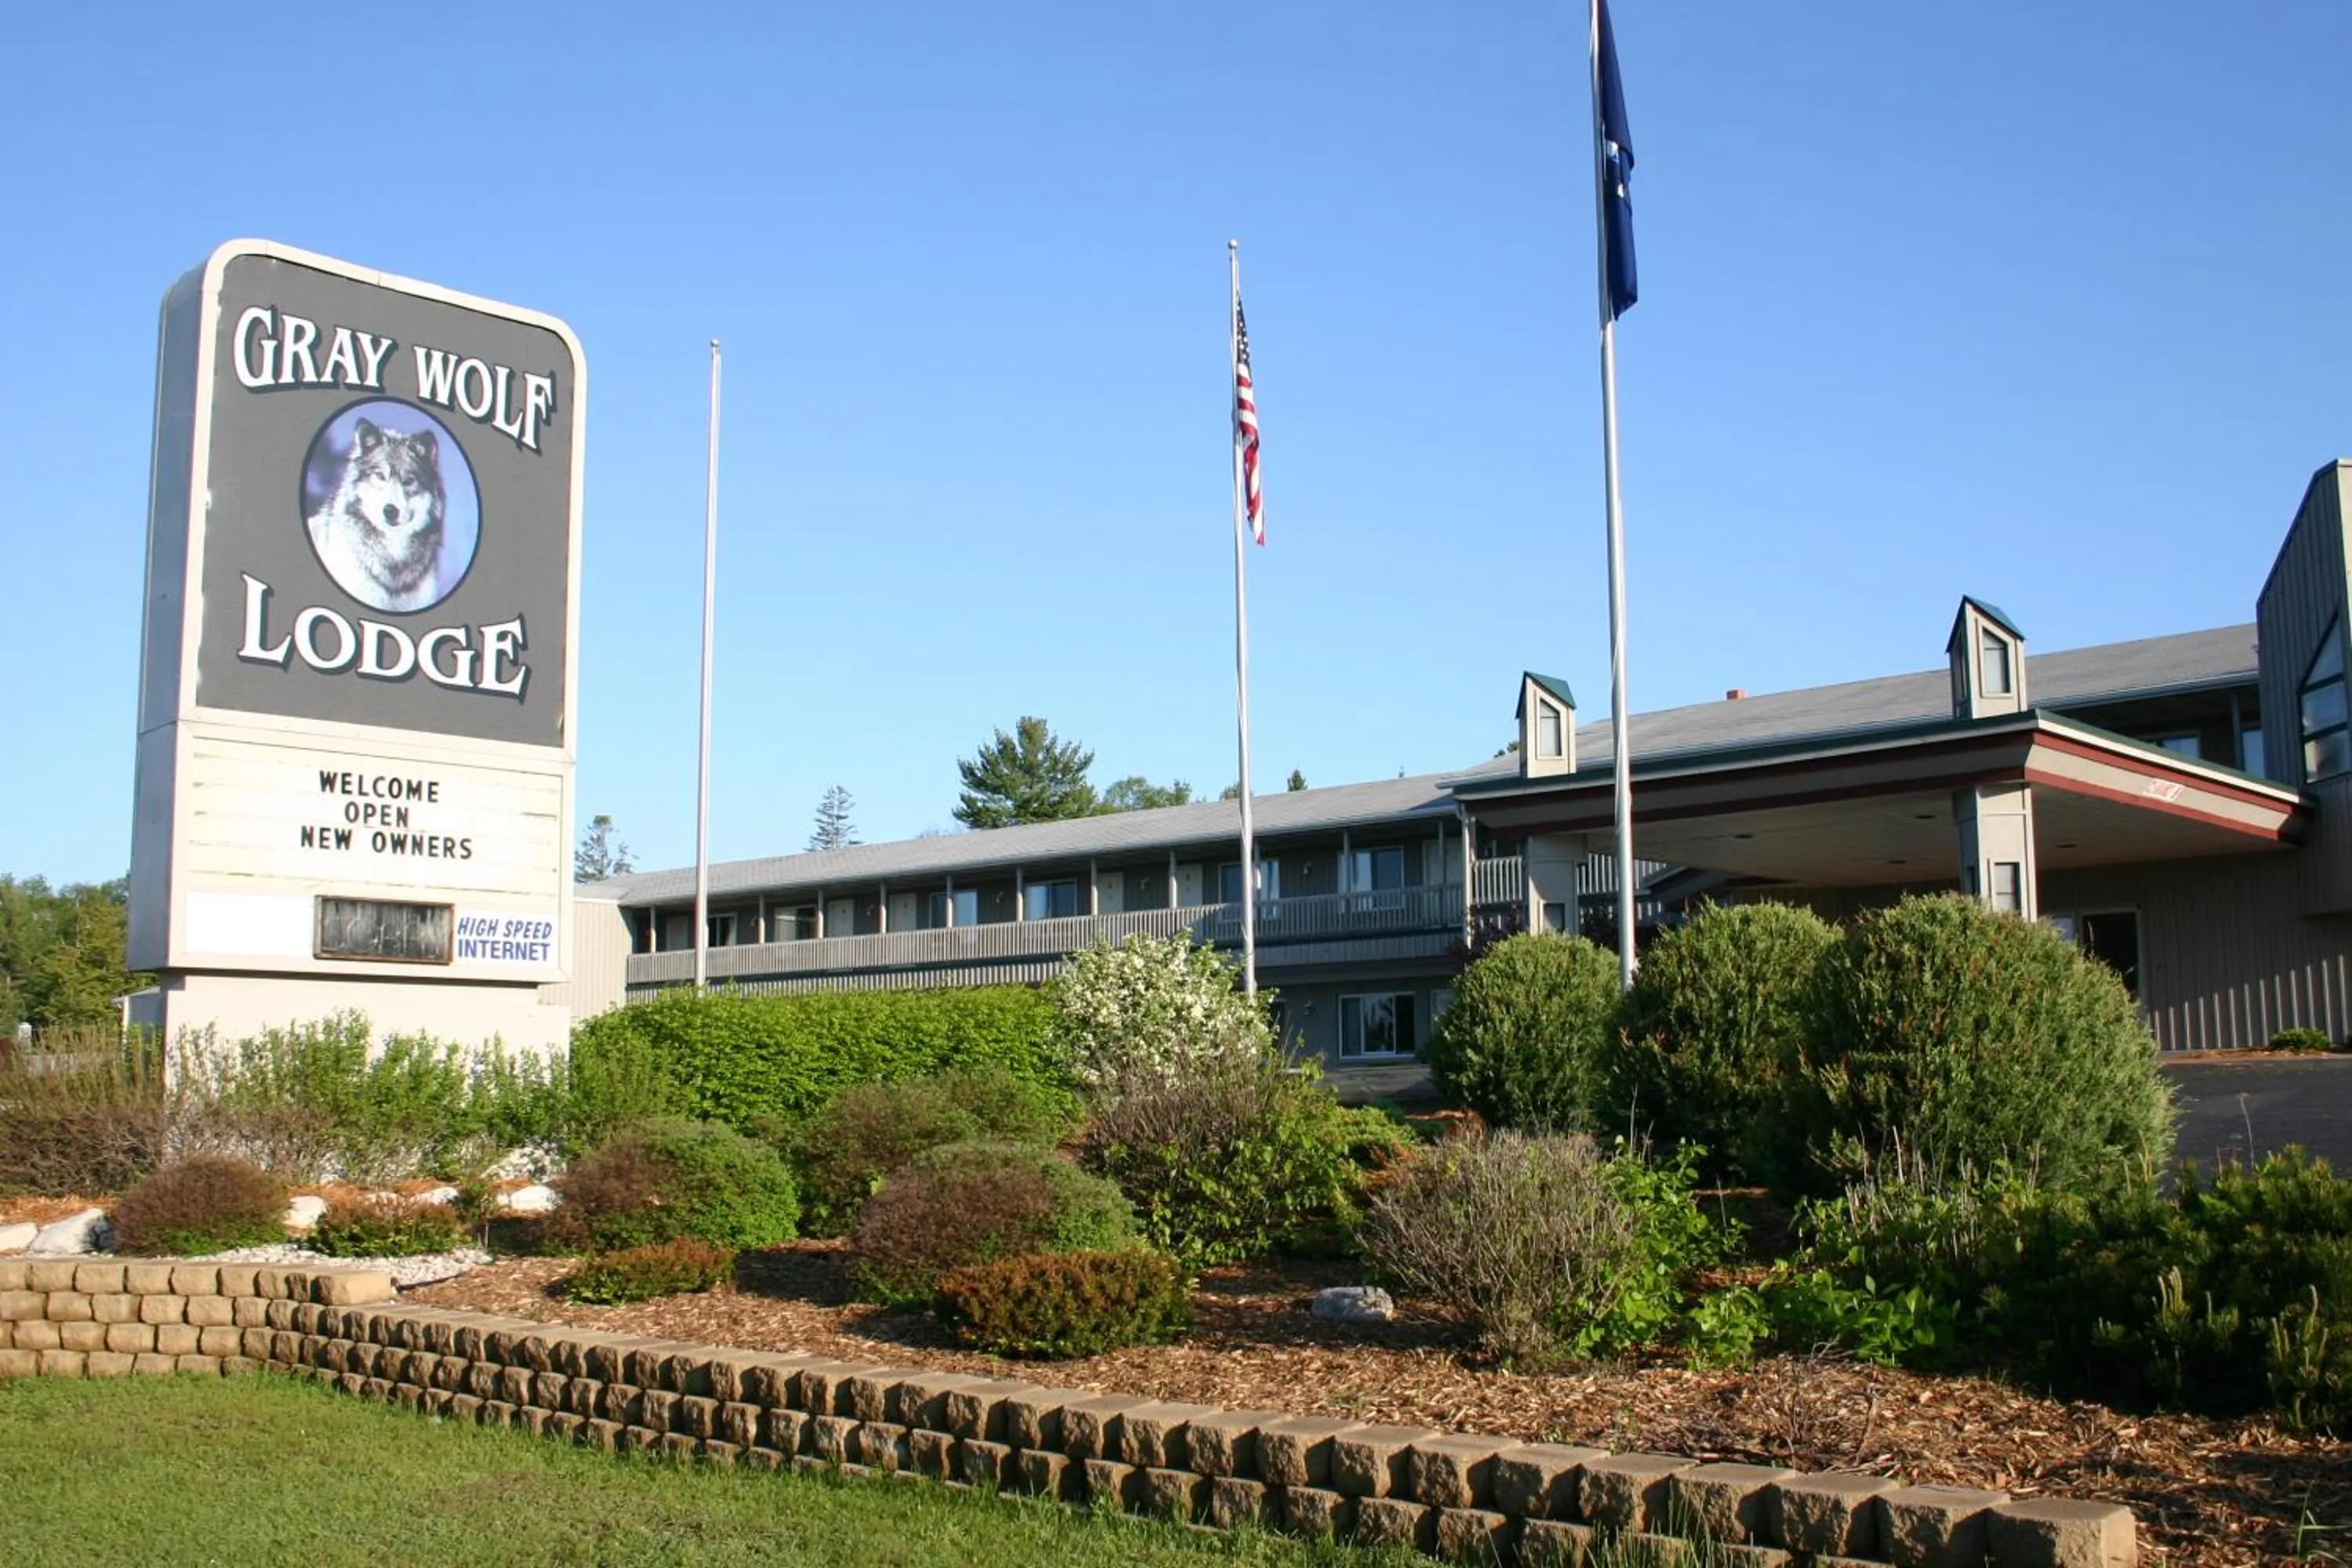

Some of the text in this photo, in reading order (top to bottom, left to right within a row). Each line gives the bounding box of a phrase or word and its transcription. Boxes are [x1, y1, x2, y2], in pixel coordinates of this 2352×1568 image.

[233, 307, 553, 451] GRAY WOLF
[238, 574, 528, 696] LODGE
[319, 770, 440, 804] WELCOME
[344, 801, 409, 828] OPEN
[300, 826, 473, 859] NEW OWNERS
[457, 916, 499, 938] HIGH
[503, 920, 553, 940] SPEED
[458, 938, 550, 961] INTERNET
